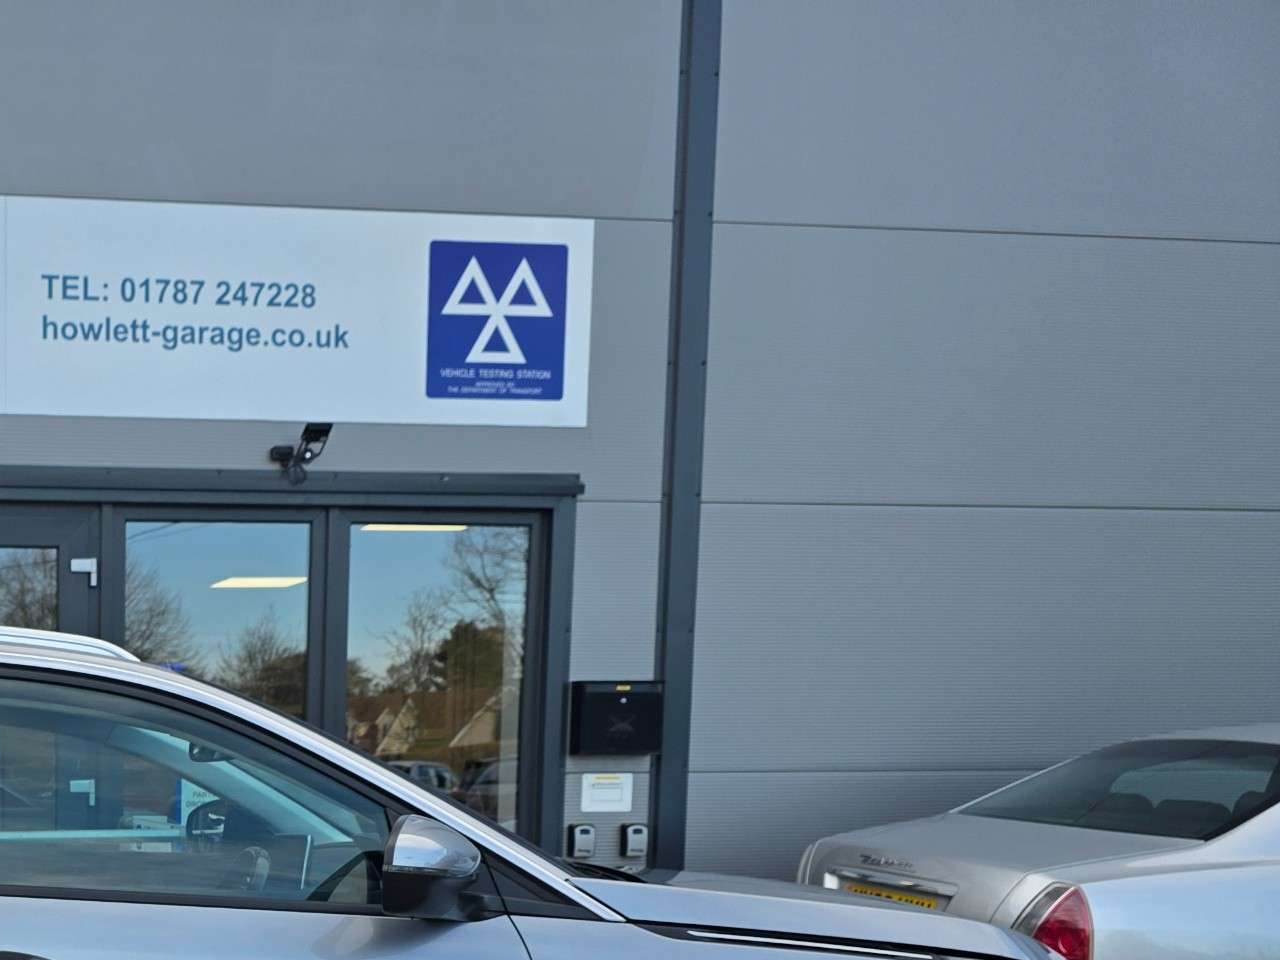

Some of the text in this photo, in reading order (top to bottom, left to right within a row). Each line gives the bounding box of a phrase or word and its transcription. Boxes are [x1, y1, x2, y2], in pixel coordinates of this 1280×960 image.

[41, 274, 317, 309] TEL: 01787 247228
[41, 314, 349, 352] howlett-garage.co.uk
[440, 367, 552, 380] VEHICLE TESTING STATION
